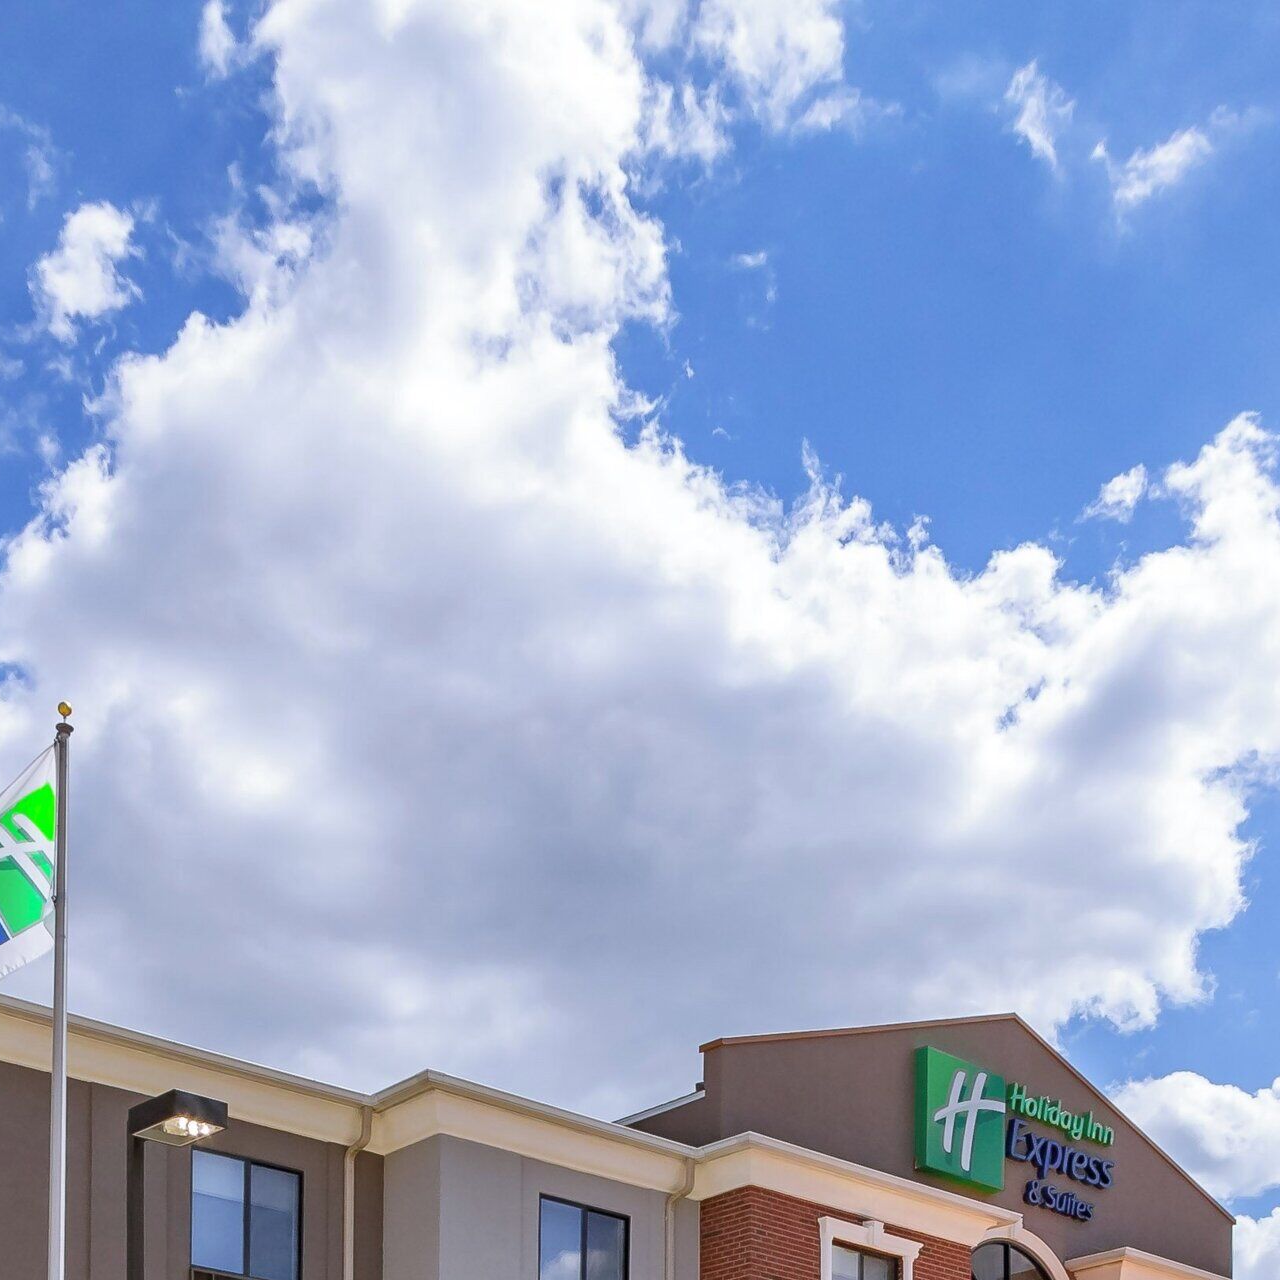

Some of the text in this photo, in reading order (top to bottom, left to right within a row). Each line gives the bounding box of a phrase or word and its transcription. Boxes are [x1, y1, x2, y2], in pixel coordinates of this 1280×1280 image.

[1009, 1082, 1115, 1146] Holiday Inn
[1007, 1118, 1115, 1189] Express
[1024, 1179, 1095, 1222] & Suites
